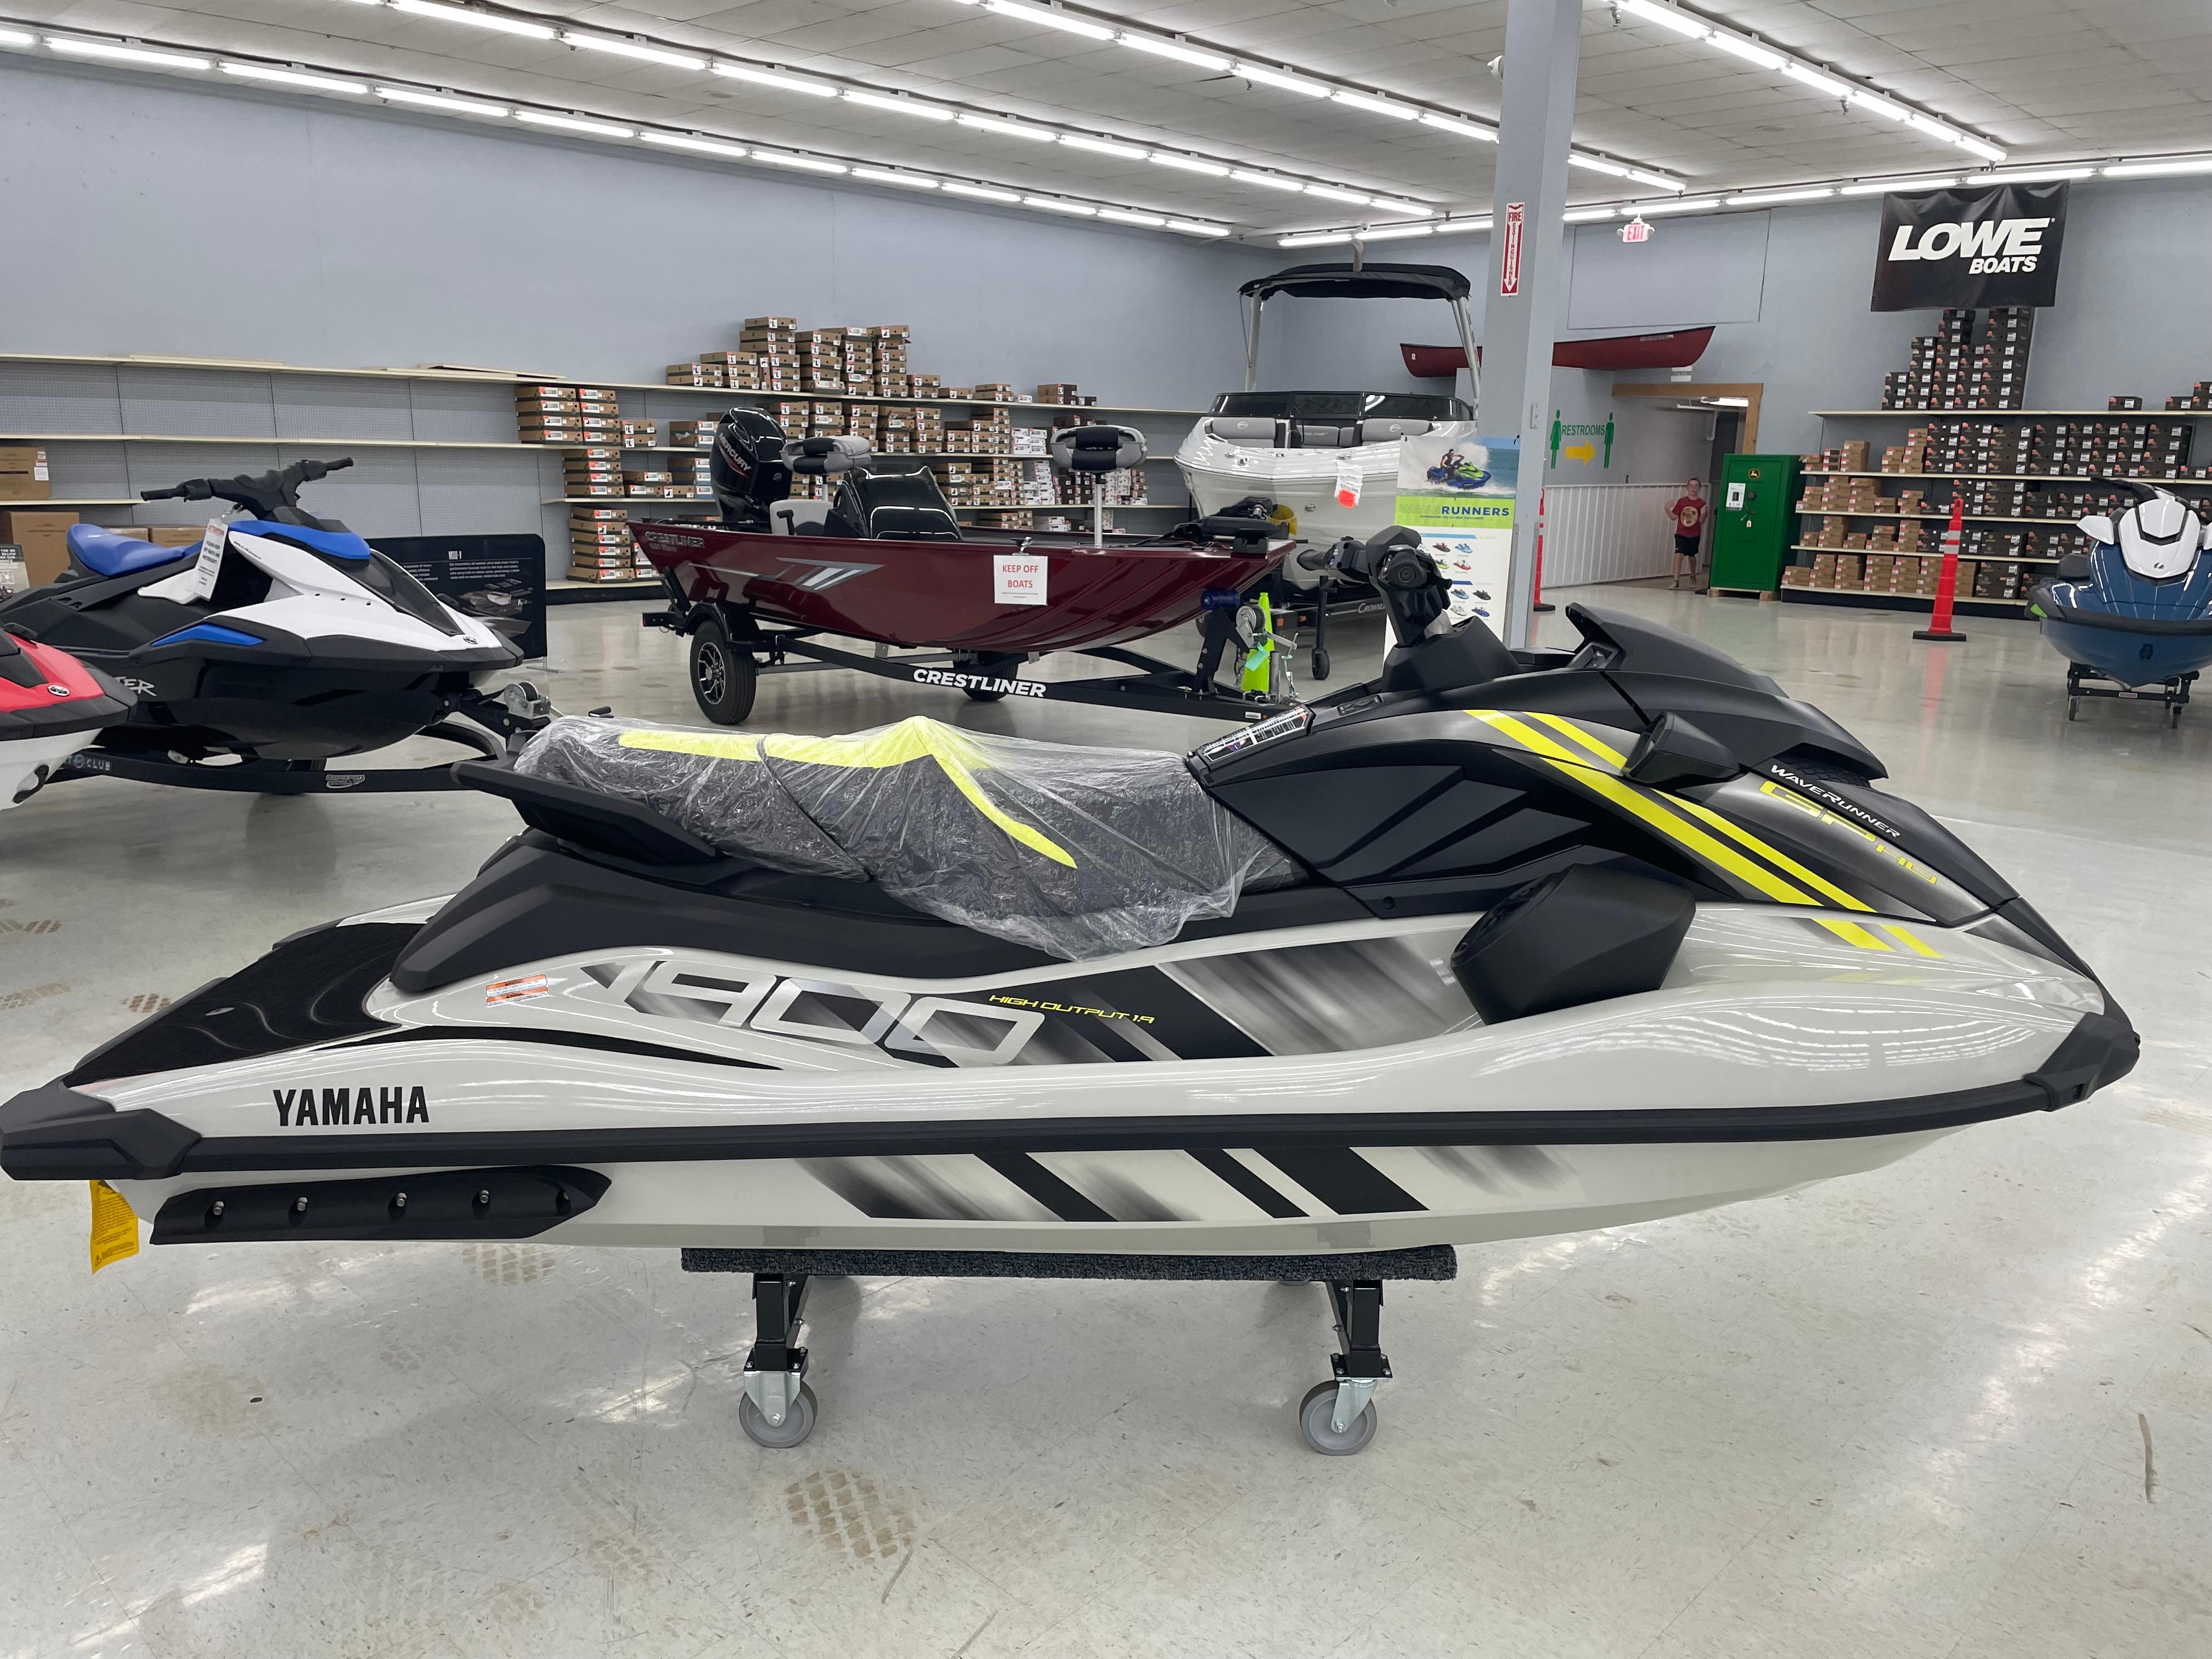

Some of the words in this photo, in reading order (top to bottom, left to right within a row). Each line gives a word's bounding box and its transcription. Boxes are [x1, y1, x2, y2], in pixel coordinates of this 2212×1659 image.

[1509, 211, 1522, 222] FIRE
[1627, 225, 1645, 240] EXIT
[1888, 217, 2050, 261] LOWE
[1968, 256, 2038, 274] BOATS
[1561, 425, 1605, 436] RESTROOMS
[719, 432, 752, 471] MERCURY
[645, 531, 706, 549] CRESTLINER
[1008, 580, 1032, 588] BOATS
[913, 669, 1046, 697] CRESTLINER
[989, 995, 1039, 1007] HIGH
[1040, 1002, 1130, 1019] OUTPUT
[1132, 1014, 1155, 1024] 1.9
[273, 1086, 430, 1126] YAMAHA
